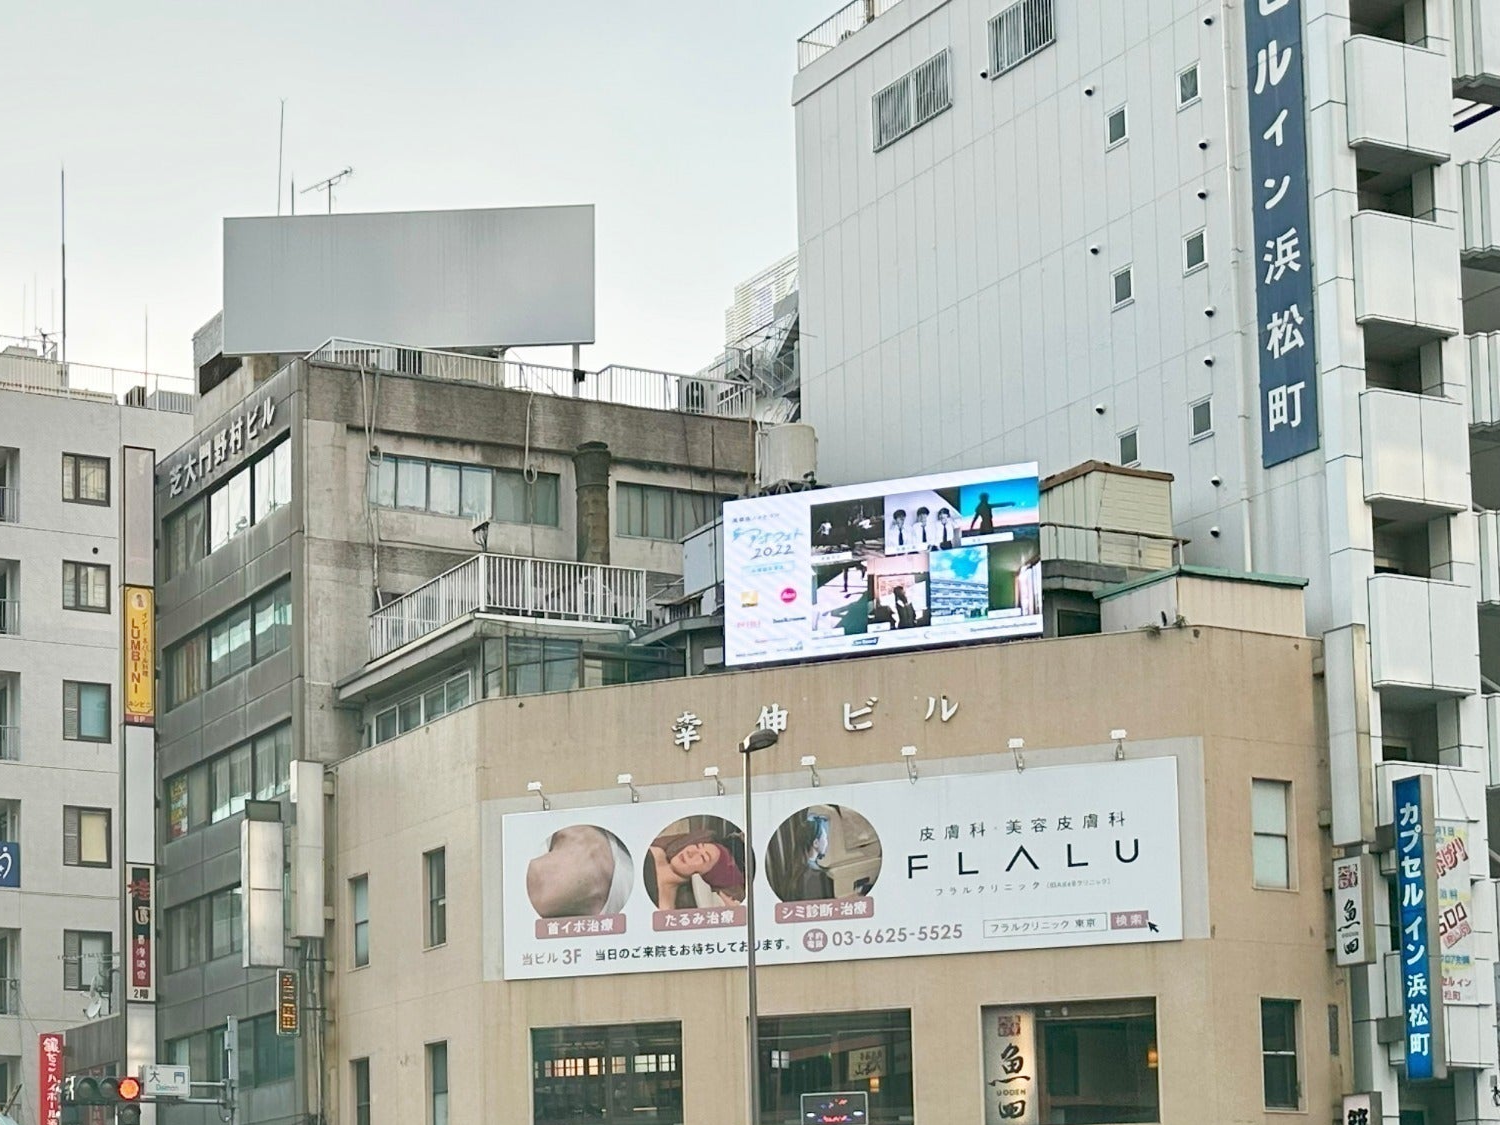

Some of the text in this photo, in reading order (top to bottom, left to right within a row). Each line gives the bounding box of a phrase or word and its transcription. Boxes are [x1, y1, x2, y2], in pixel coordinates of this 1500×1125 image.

[169, 396, 275, 498] 芝大門野村ビル
[750, 544, 795, 561] 2022
[131, 618, 141, 694] LUMBINI
[672, 695, 960, 751] 幸伸ビル
[547, 918, 615, 936] 首イボ治療
[664, 909, 735, 927] たるみ治療
[990, 917, 1097, 935] フラルクリニック 東京
[1115, 913, 1144, 927] 検索
[832, 923, 963, 947] 03-6625-5525
[1399, 802, 1432, 1056] カプセルイン浜松町
[562, 948, 582, 966] 3F
[149, 1070, 186, 1085] 大門
